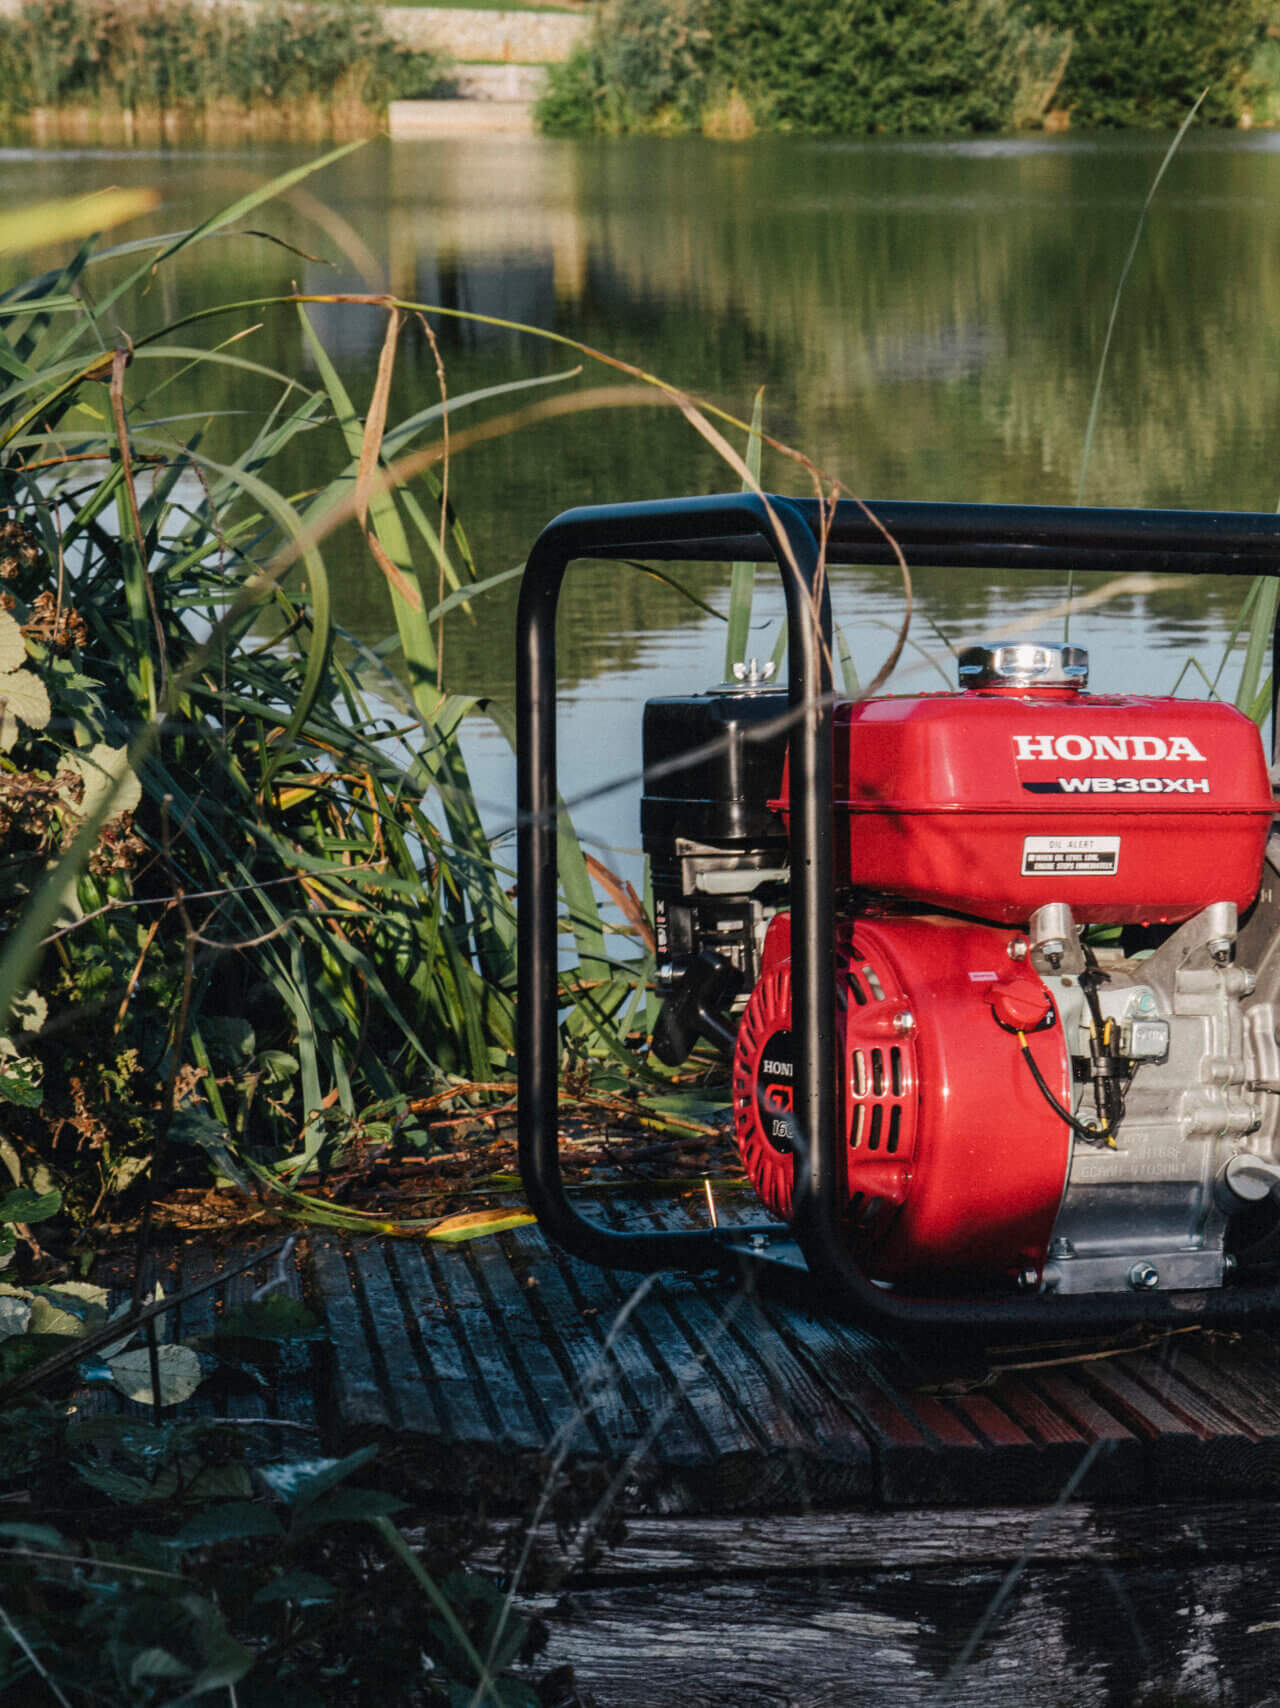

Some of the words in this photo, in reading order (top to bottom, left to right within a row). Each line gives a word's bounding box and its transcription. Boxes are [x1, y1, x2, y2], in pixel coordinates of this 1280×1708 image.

[1013, 736, 1207, 761] HONDA
[1057, 777, 1210, 793] WB30XH
[1049, 840, 1061, 848] OIL
[1067, 840, 1094, 848] ALERT
[763, 1060, 793, 1076] HON
